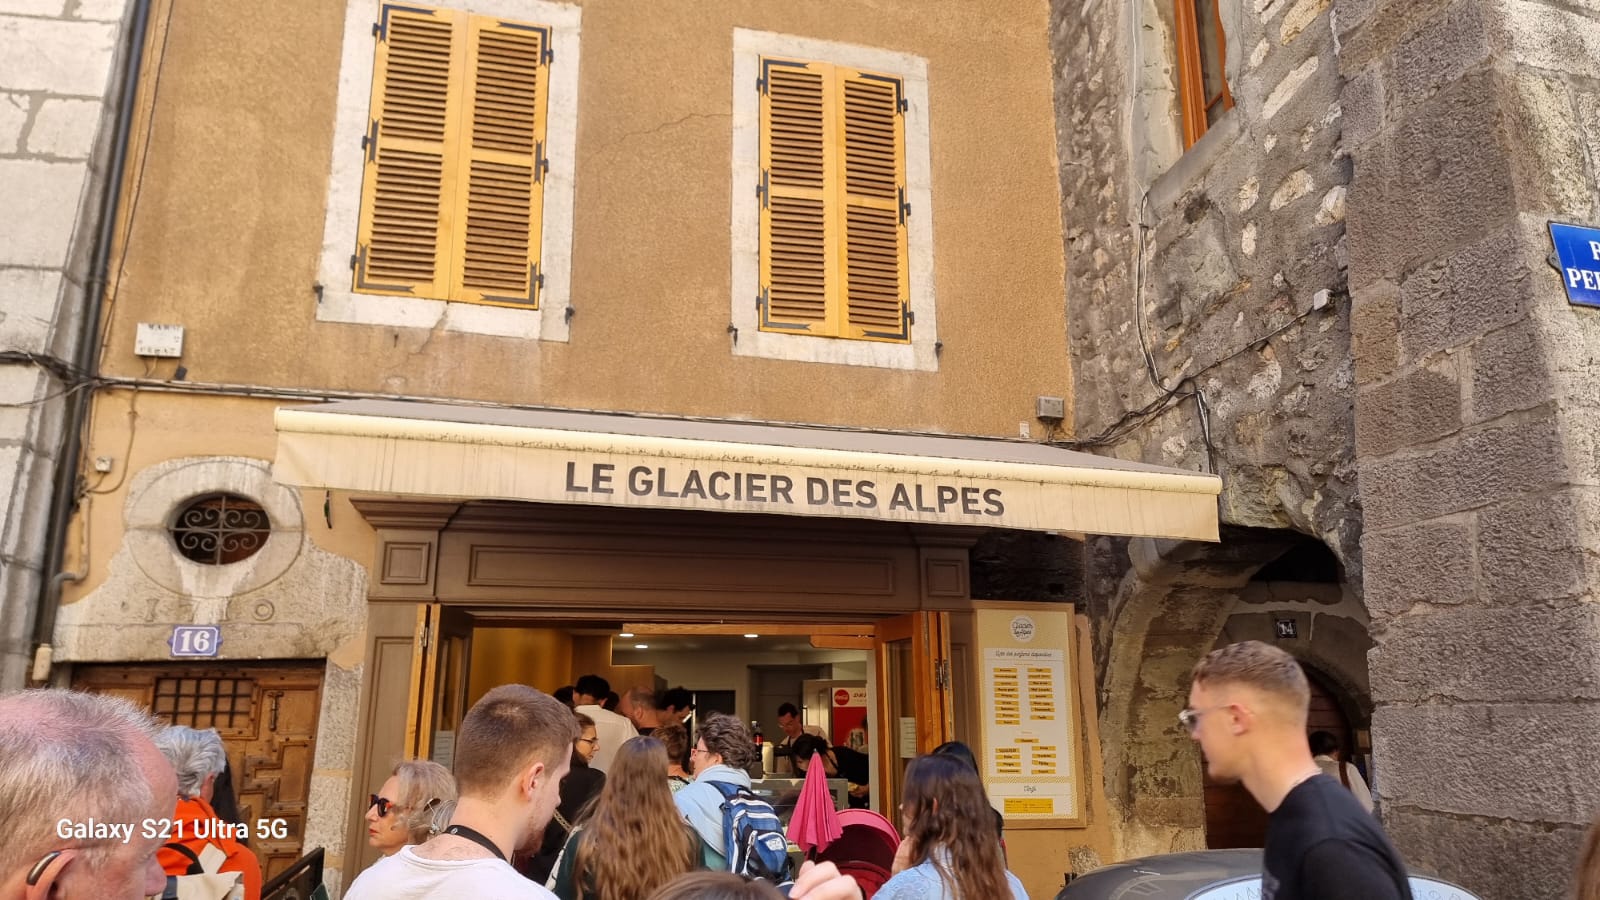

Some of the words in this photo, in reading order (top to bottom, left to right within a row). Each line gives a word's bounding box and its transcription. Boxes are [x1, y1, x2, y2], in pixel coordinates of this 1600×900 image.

[565, 461, 615, 495] LE
[628, 465, 795, 505] GLACIER
[806, 476, 878, 510] DES
[888, 482, 1006, 517] ALPES
[1279, 622, 1294, 635] 14
[180, 630, 210, 652] 16
